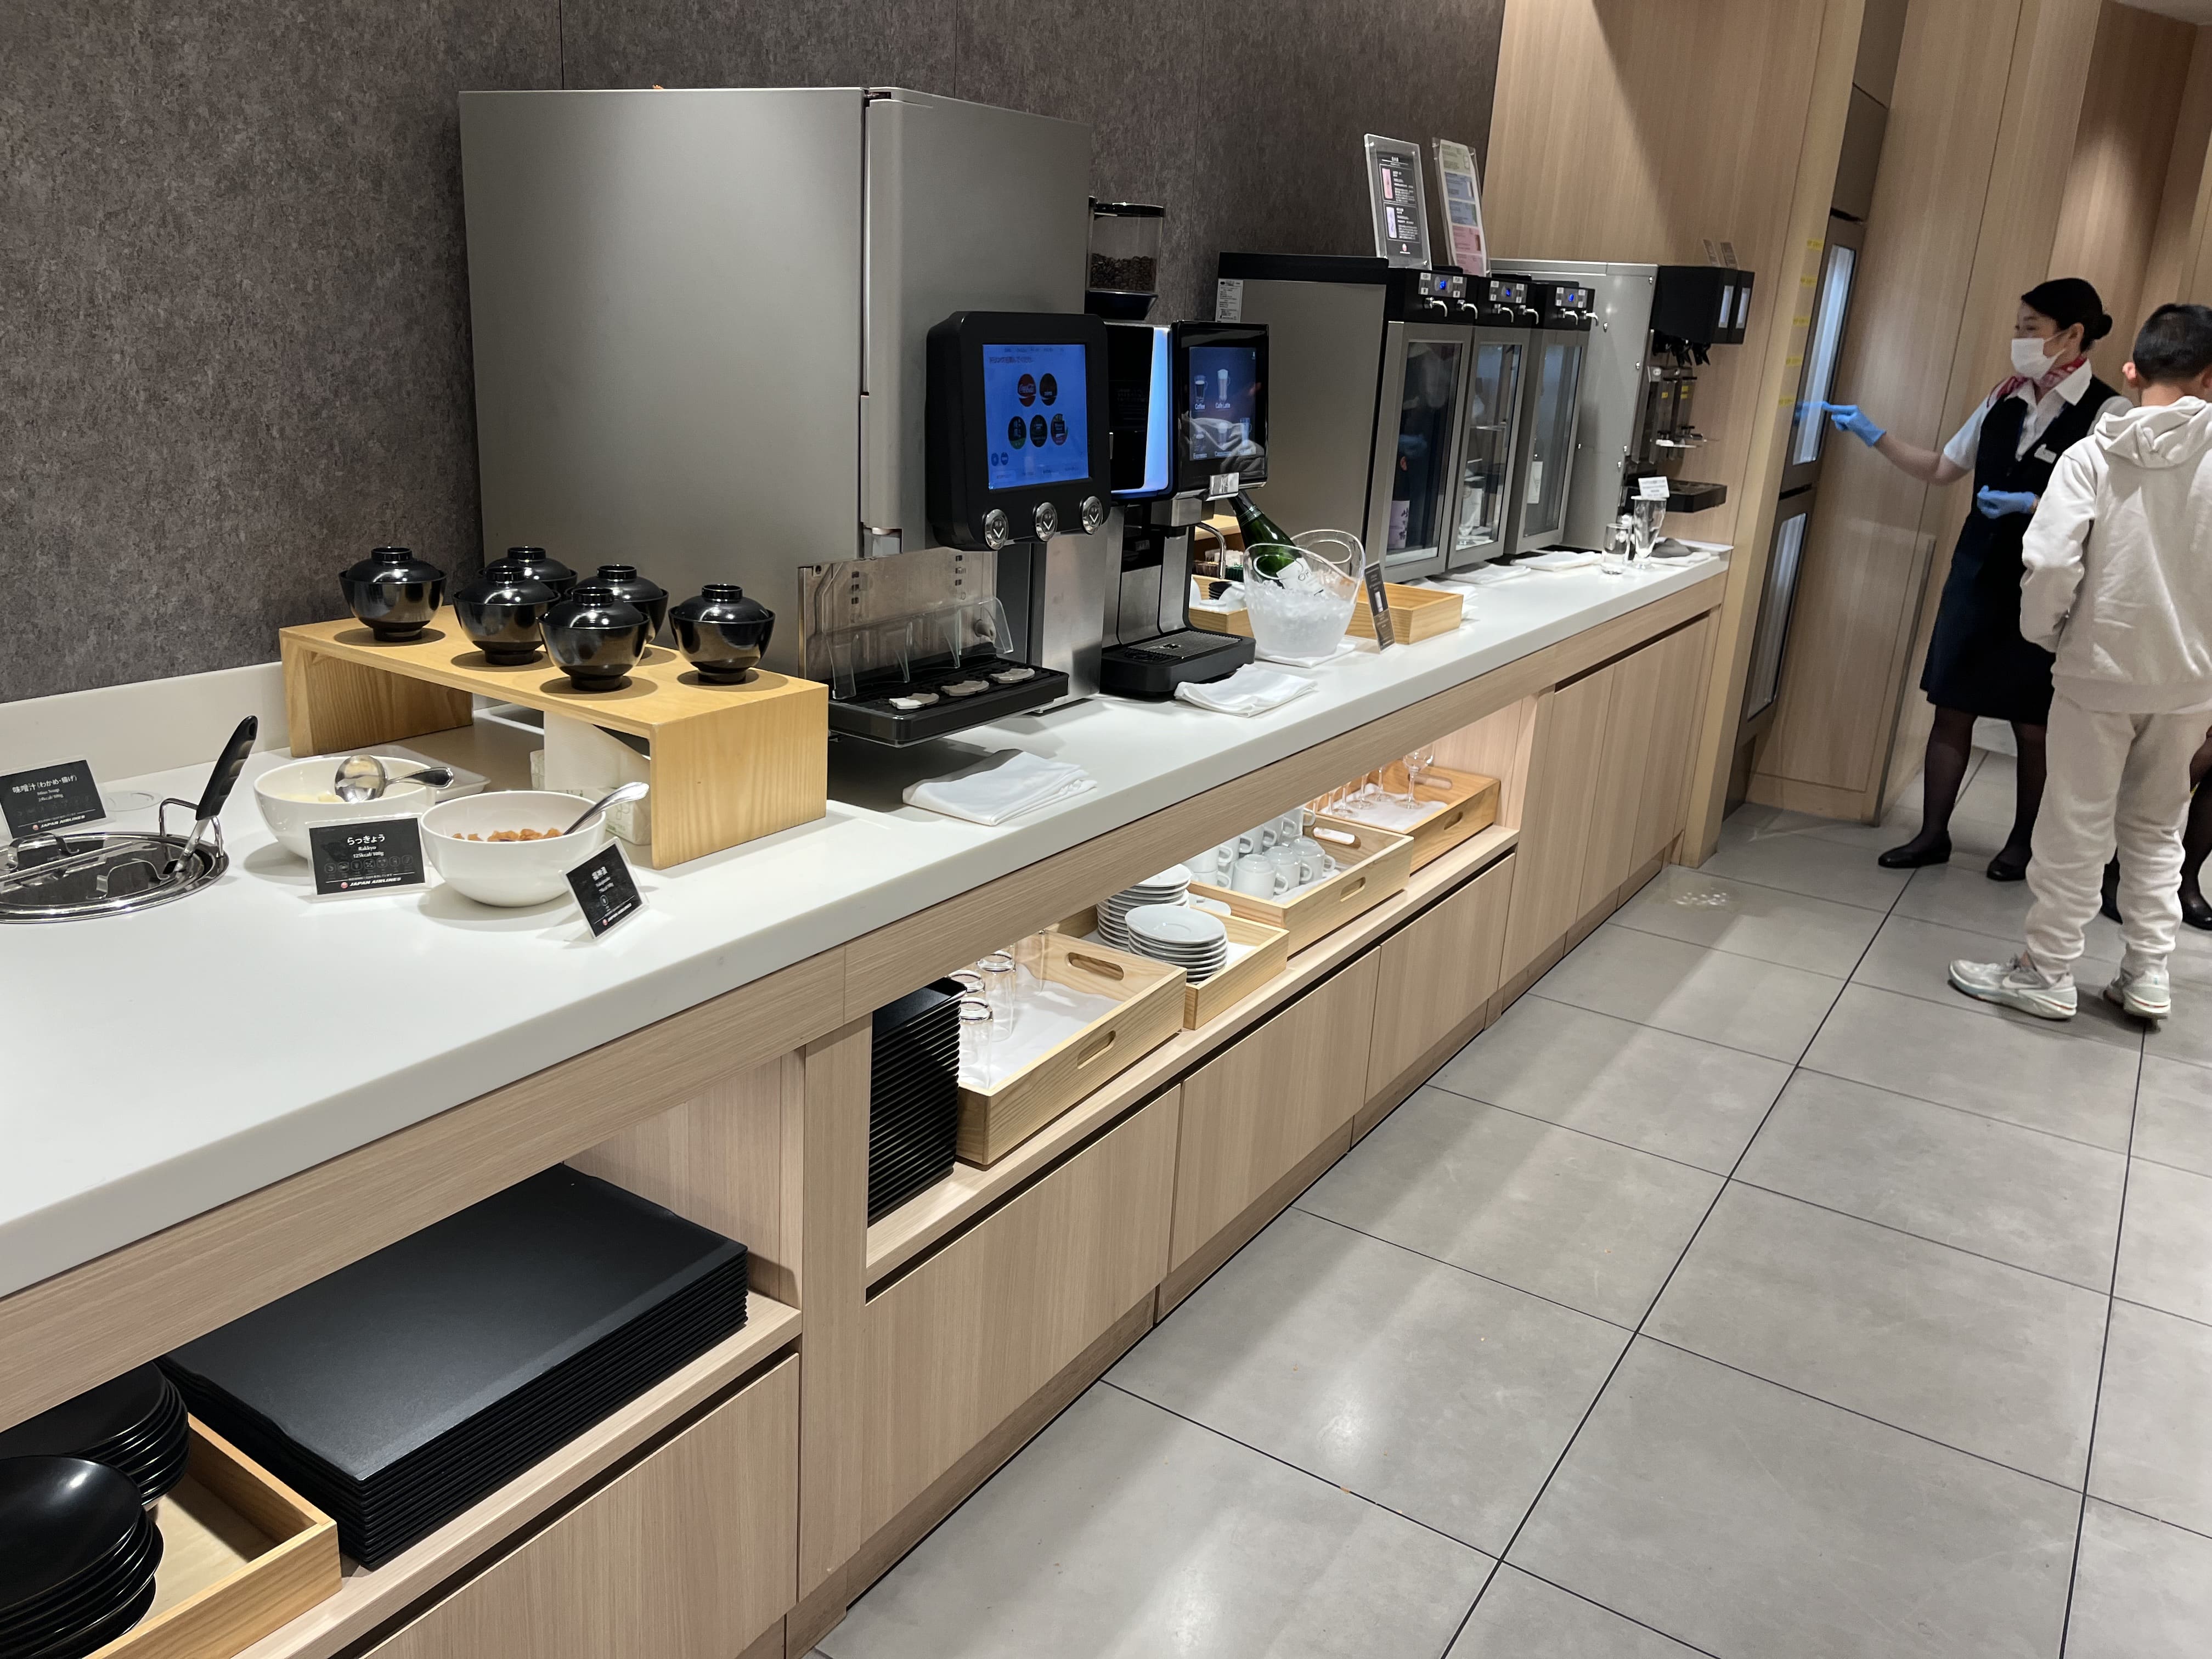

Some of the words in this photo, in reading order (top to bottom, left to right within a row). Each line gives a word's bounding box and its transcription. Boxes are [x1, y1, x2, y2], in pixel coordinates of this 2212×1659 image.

[347, 834, 385, 845] らっきょう
[371, 877, 402, 885] AIRLINES
